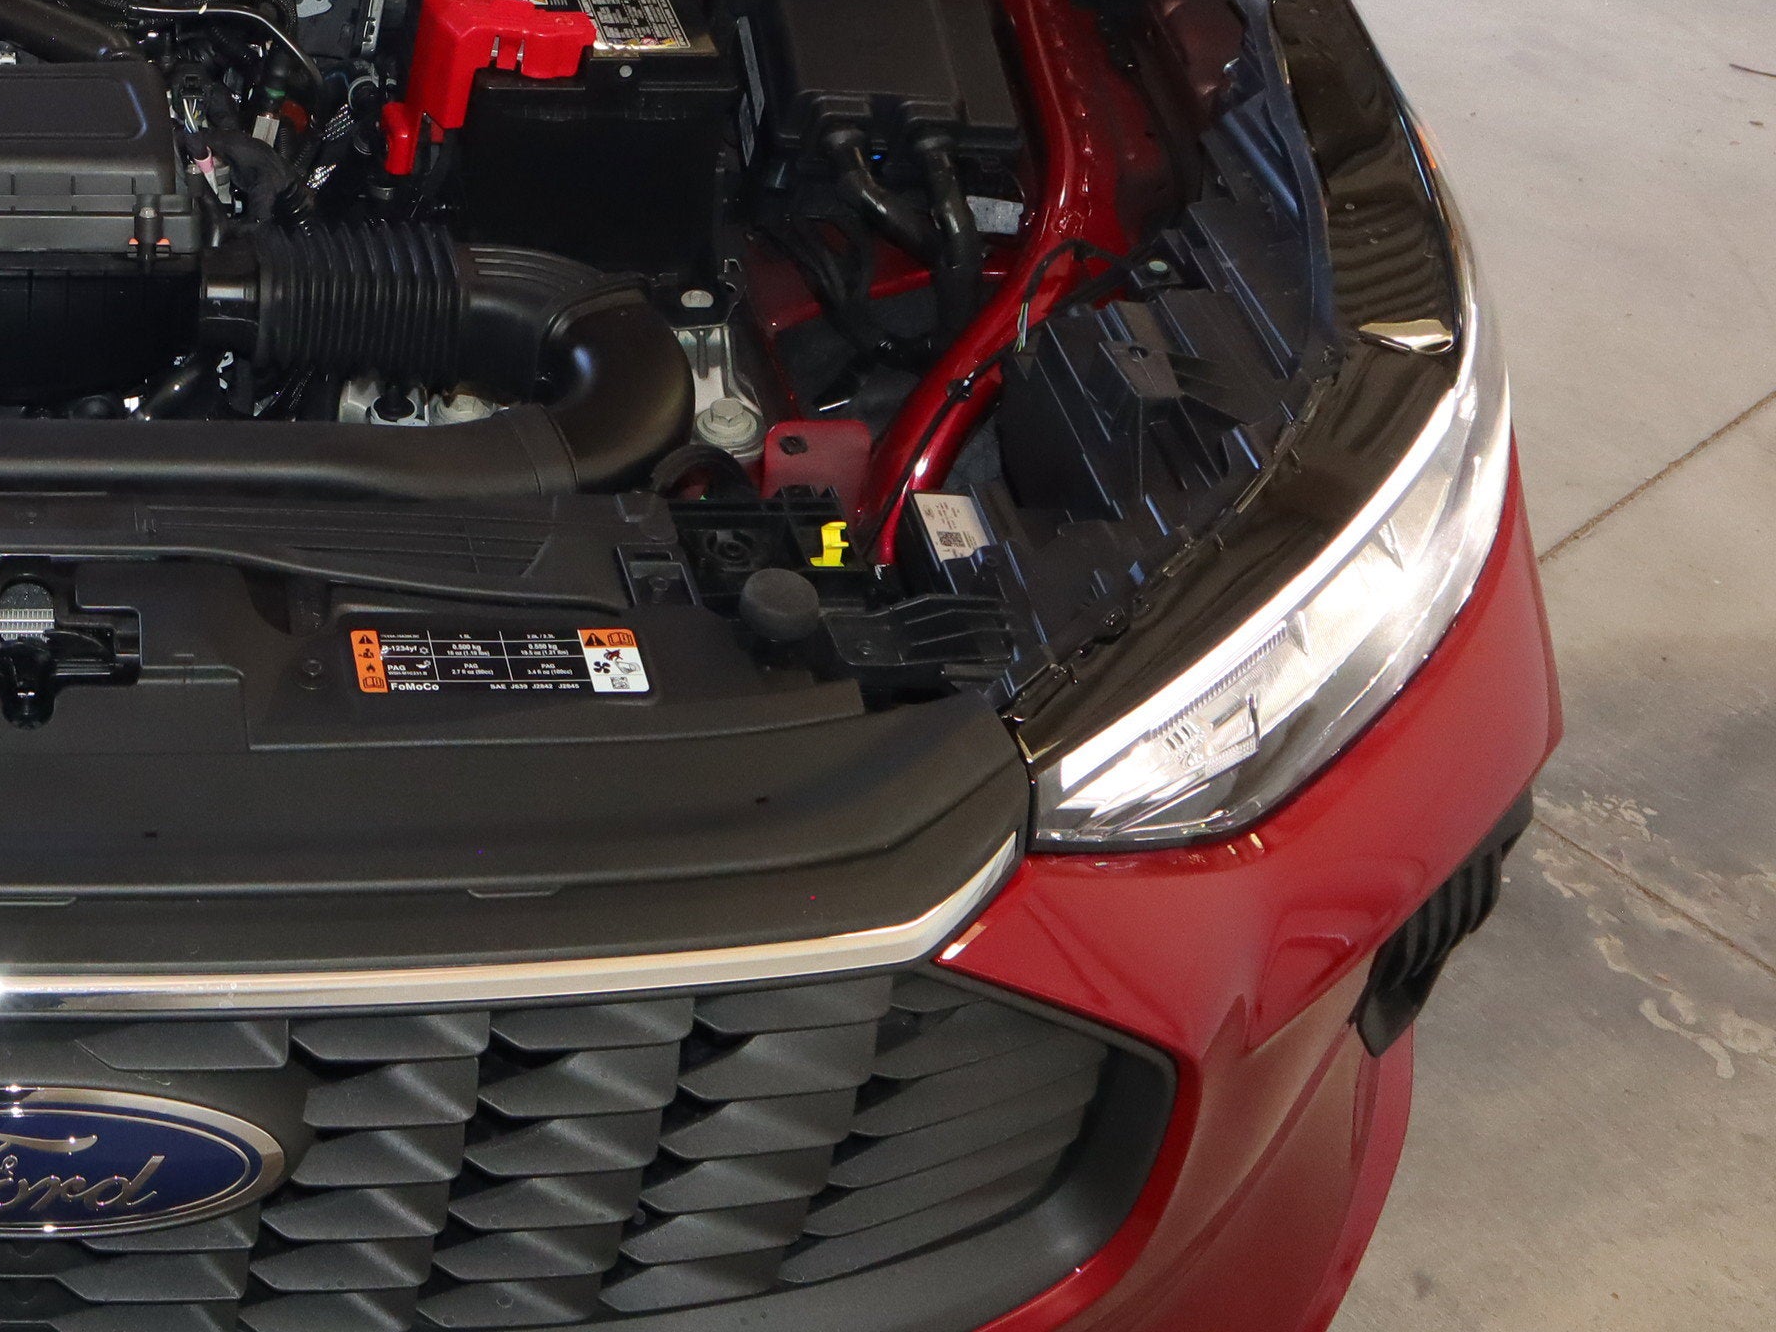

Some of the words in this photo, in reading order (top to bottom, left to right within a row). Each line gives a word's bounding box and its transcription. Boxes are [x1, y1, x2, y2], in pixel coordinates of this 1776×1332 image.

[471, 643, 482, 651] kg
[548, 643, 558, 651] kg
[391, 682, 440, 691] FoMoCo
